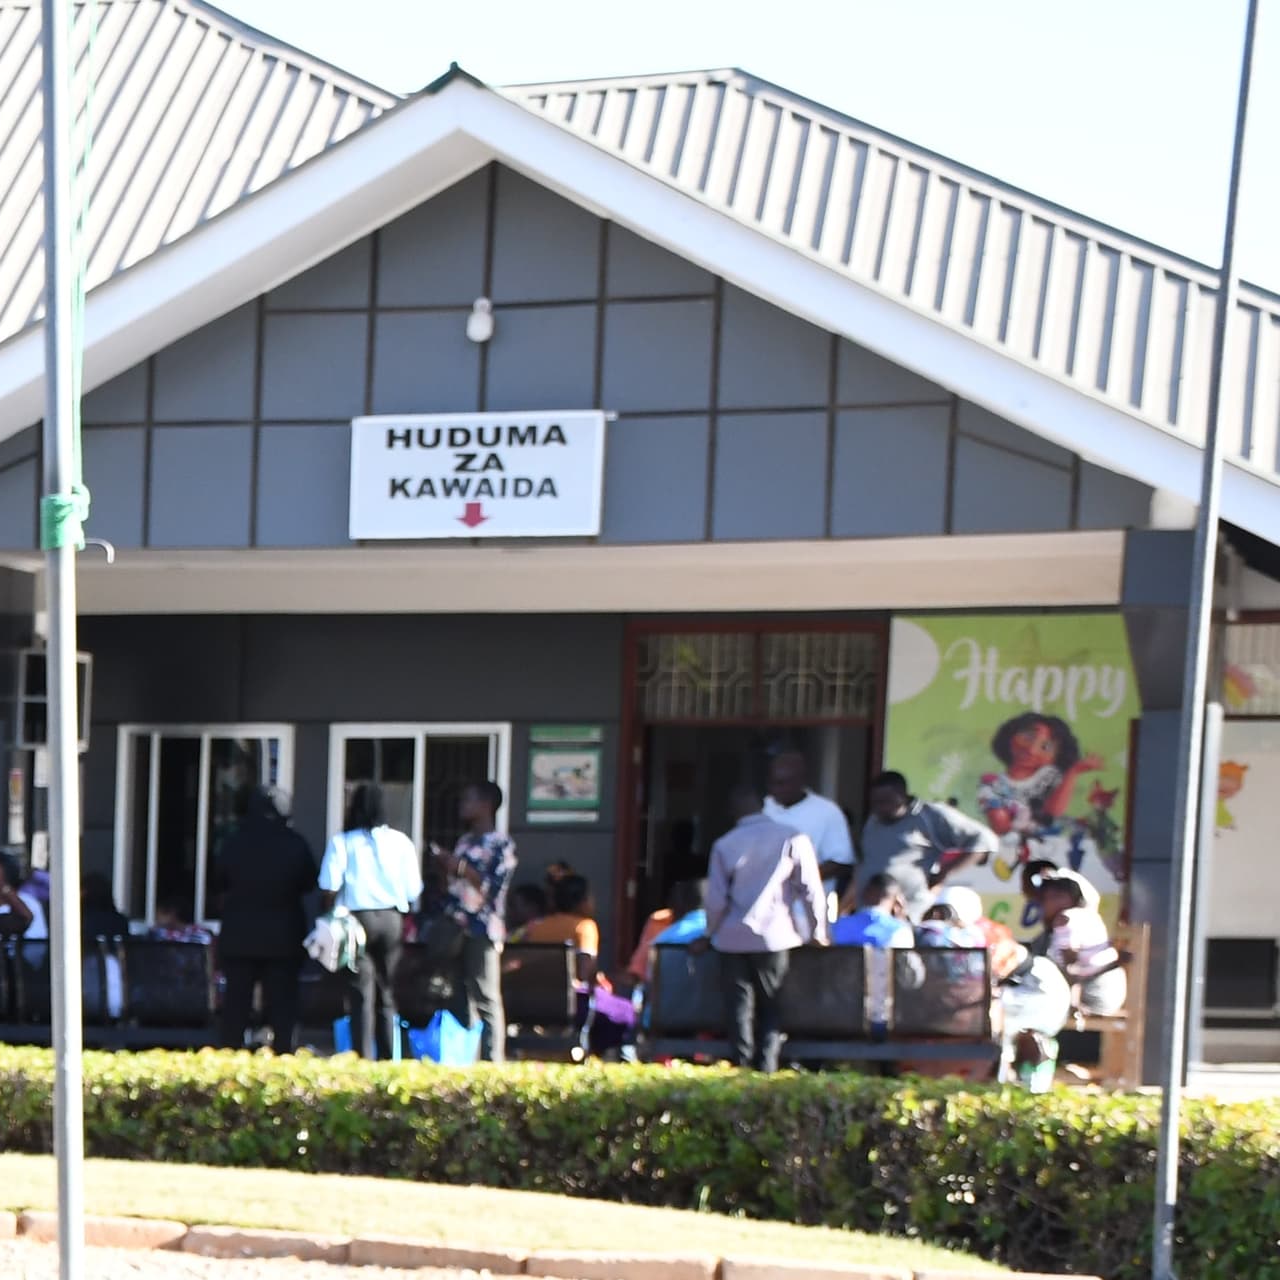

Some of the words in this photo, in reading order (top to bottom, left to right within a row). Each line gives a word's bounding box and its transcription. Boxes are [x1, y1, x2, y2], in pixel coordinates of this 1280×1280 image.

[387, 425, 567, 448] HUDUMA
[454, 453, 503, 473] ZA
[389, 478, 558, 498] KAWAIDA
[944, 637, 1127, 721] Happy
